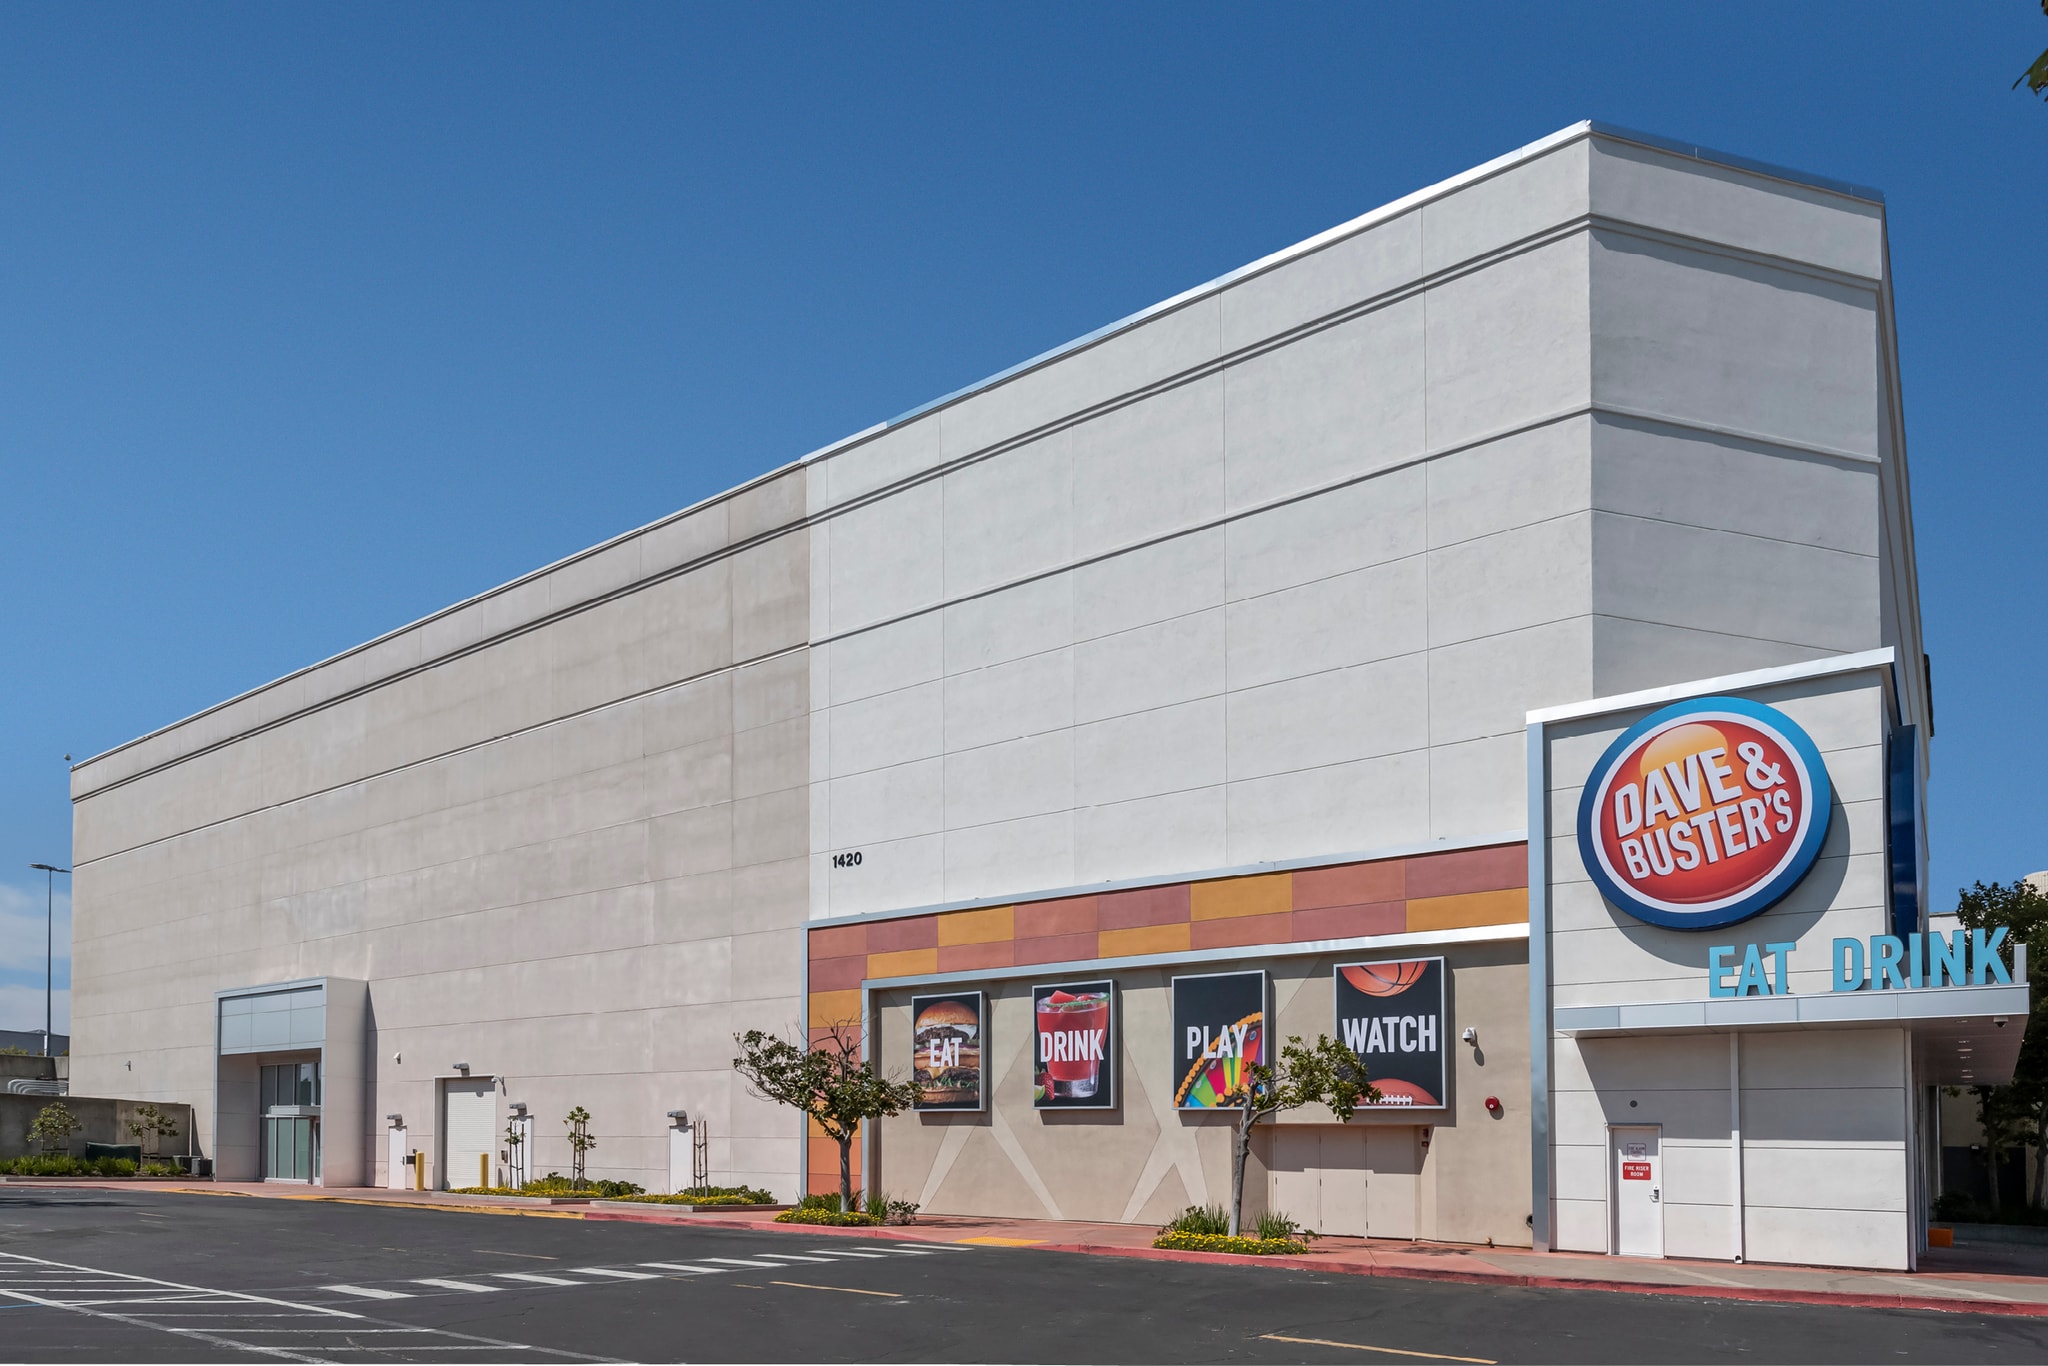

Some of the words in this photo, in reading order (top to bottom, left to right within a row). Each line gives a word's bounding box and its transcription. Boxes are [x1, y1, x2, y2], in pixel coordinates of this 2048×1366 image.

[1614, 746, 1743, 838] DAVE
[1737, 741, 1786, 791] &
[1620, 788, 1794, 880] BUSTER'S
[832, 851, 863, 869] 1420
[1709, 941, 1796, 997] EAT
[1832, 926, 2012, 992] DRINK
[929, 1037, 963, 1068] EAT
[1040, 1028, 1104, 1063] DRINK
[1186, 1023, 1249, 1060] PLAY
[1342, 1014, 1437, 1054] WATCH
